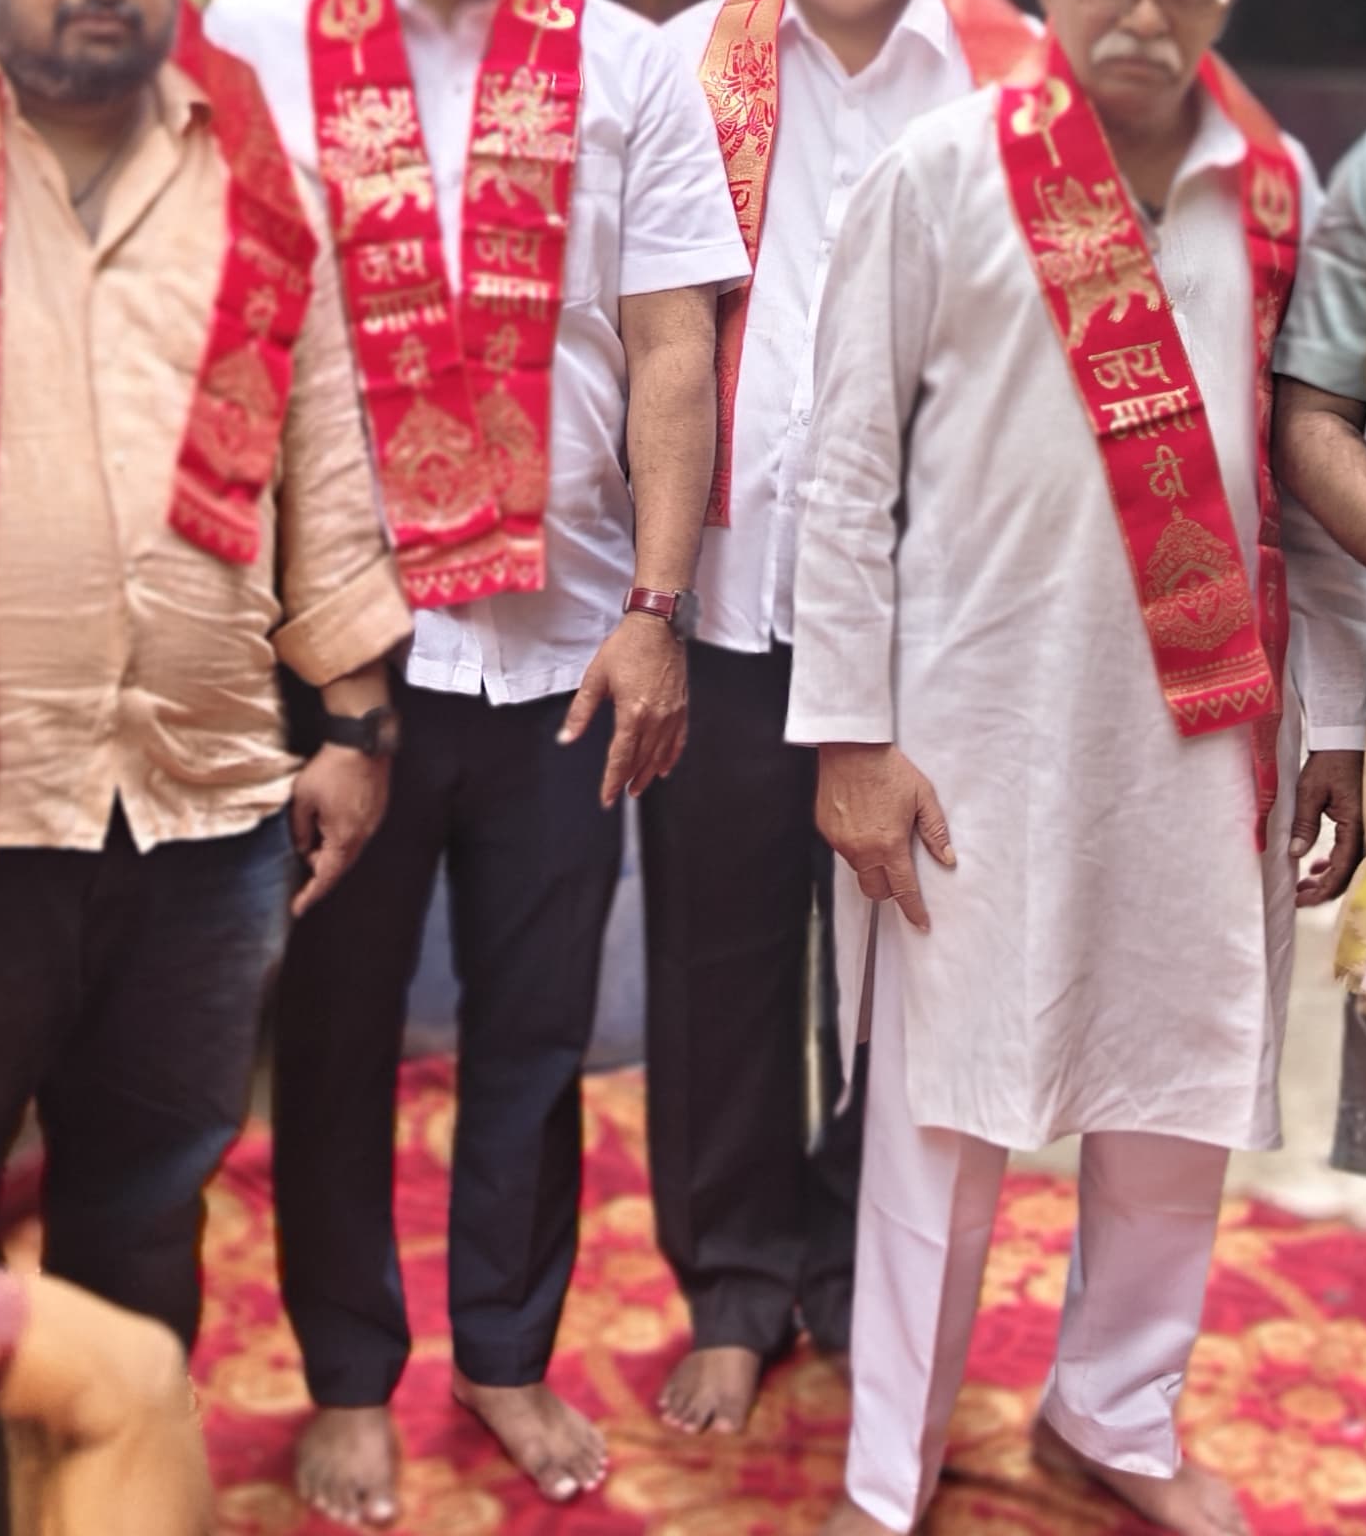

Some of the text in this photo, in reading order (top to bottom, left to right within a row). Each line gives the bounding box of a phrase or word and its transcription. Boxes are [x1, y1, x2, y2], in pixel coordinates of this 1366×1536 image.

[356, 236, 428, 284] जय
[1088, 340, 1172, 390] जय
[1100, 385, 1196, 440] माता
[1142, 444, 1190, 502] दी
